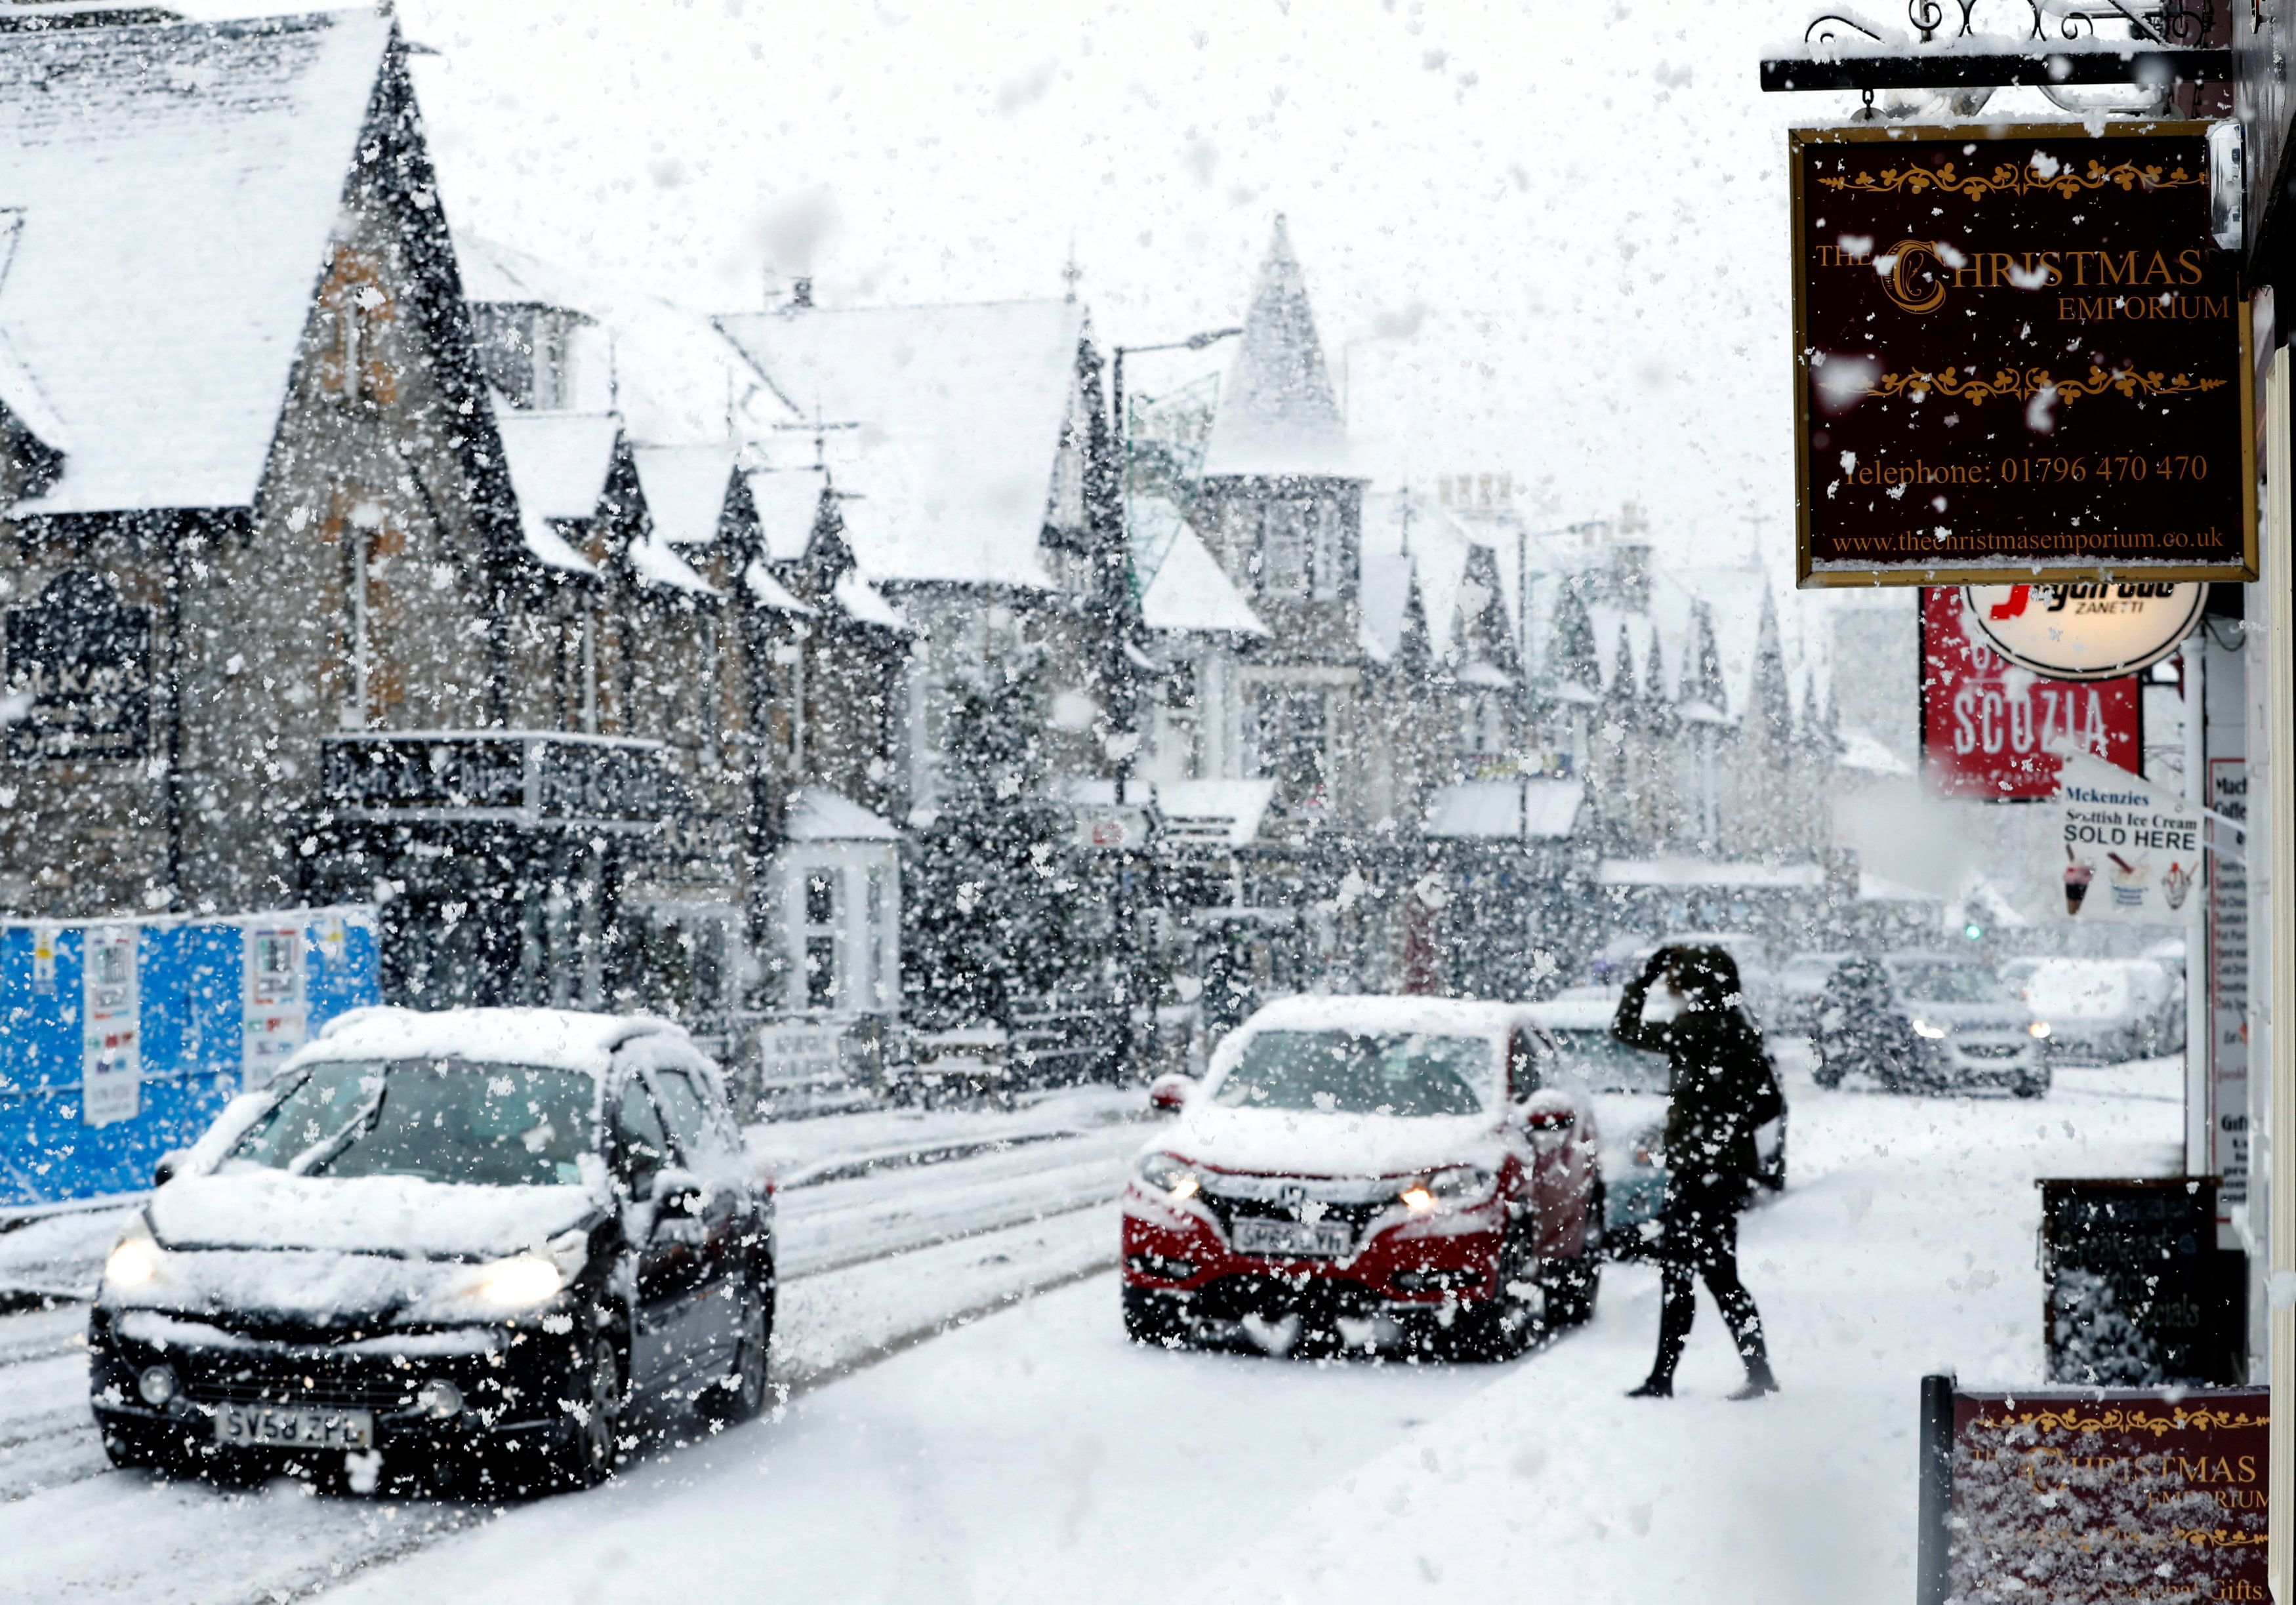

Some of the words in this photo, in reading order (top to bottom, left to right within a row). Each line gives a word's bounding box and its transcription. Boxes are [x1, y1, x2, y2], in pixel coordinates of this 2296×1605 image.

[1880, 239, 2203, 315] CHRISTMAS
[2057, 296, 2230, 321] EMPORIUM
[2001, 457, 2087, 483] 01796
[2096, 456, 2147, 481] 470
[2156, 455, 2207, 481] 470
[1832, 526, 2224, 556] www.thechristmasemporium.co.uk
[2075, 600, 2144, 615] ZANETTI
[1953, 689, 2106, 755] SCOZIA
[2127, 812, 2148, 827] Ice
[2152, 814, 2198, 830] Cream
[2064, 824, 2126, 845] SOLD
[2135, 830, 2196, 851] HERE
[2148, 1490, 2270, 1510] EMRIUM
[2207, 1579, 2263, 1601] Gifts
